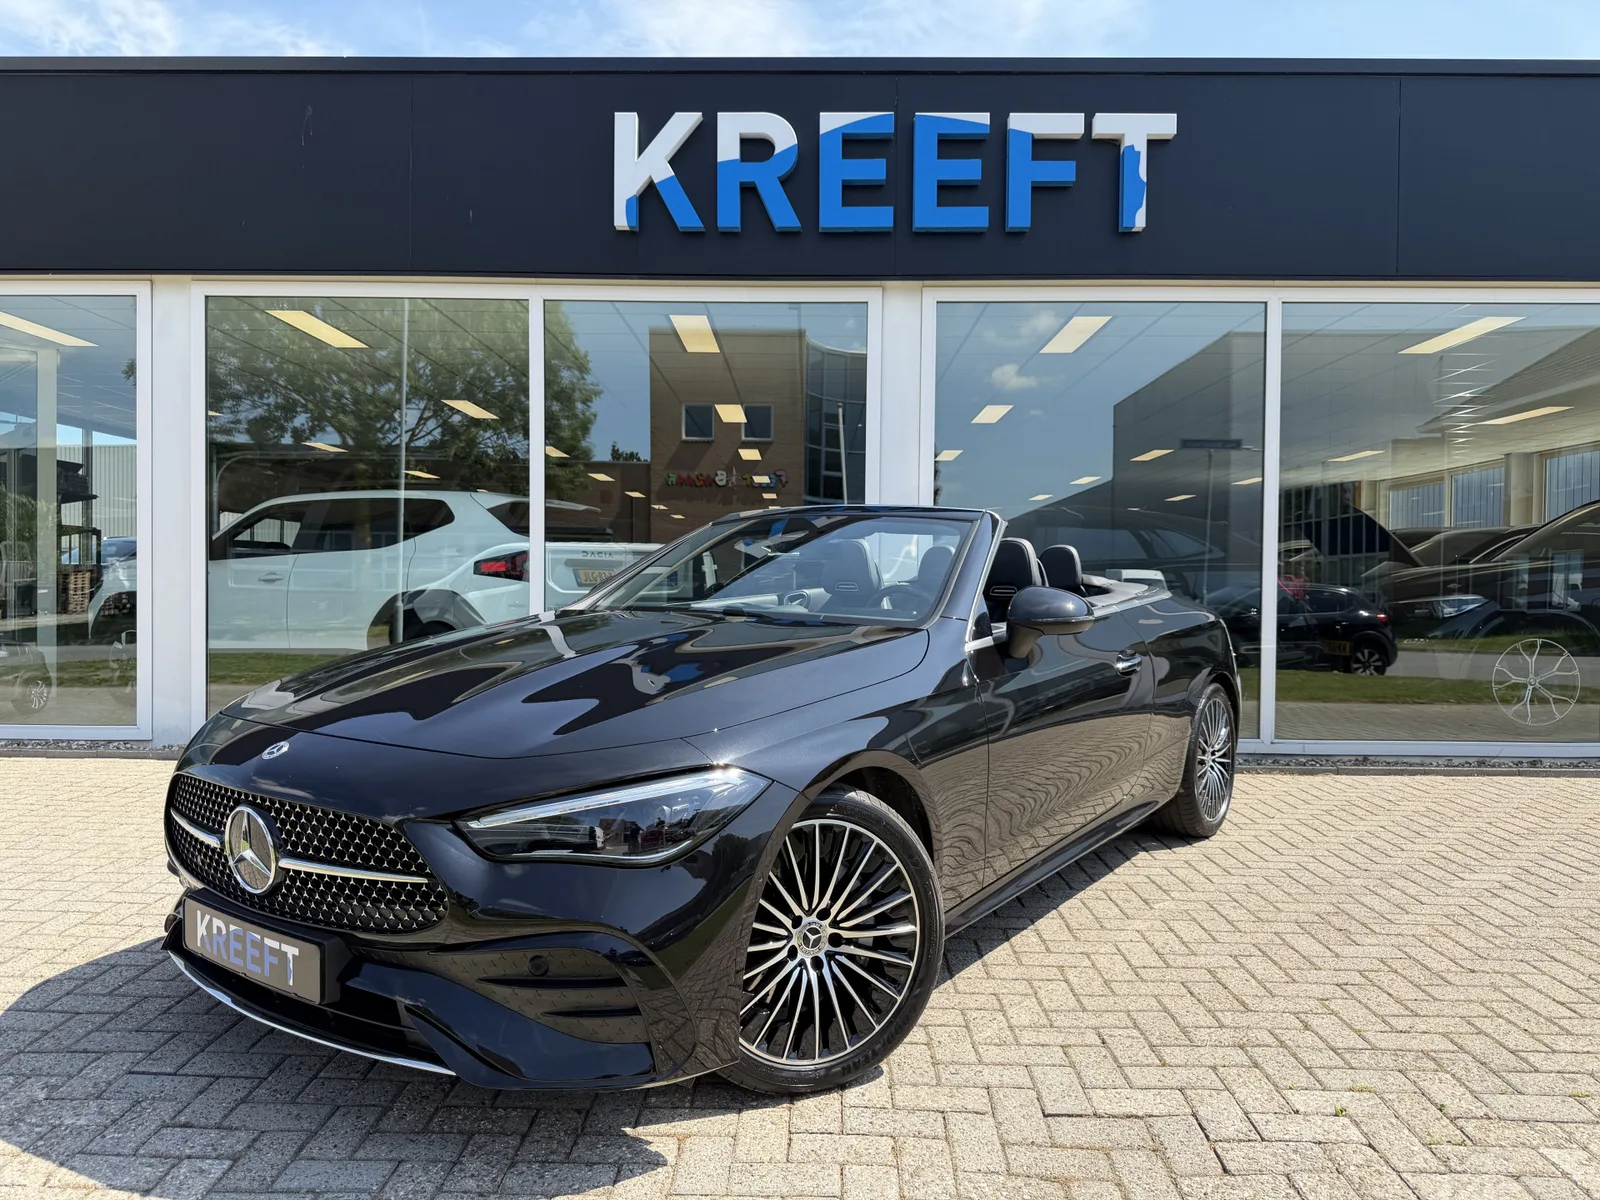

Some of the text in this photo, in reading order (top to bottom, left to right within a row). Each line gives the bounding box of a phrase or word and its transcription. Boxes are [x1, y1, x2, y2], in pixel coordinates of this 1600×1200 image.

[613, 111, 1178, 233] KREEFT
[581, 550, 614, 559] DACIA
[197, 910, 299, 986] KREEFT
